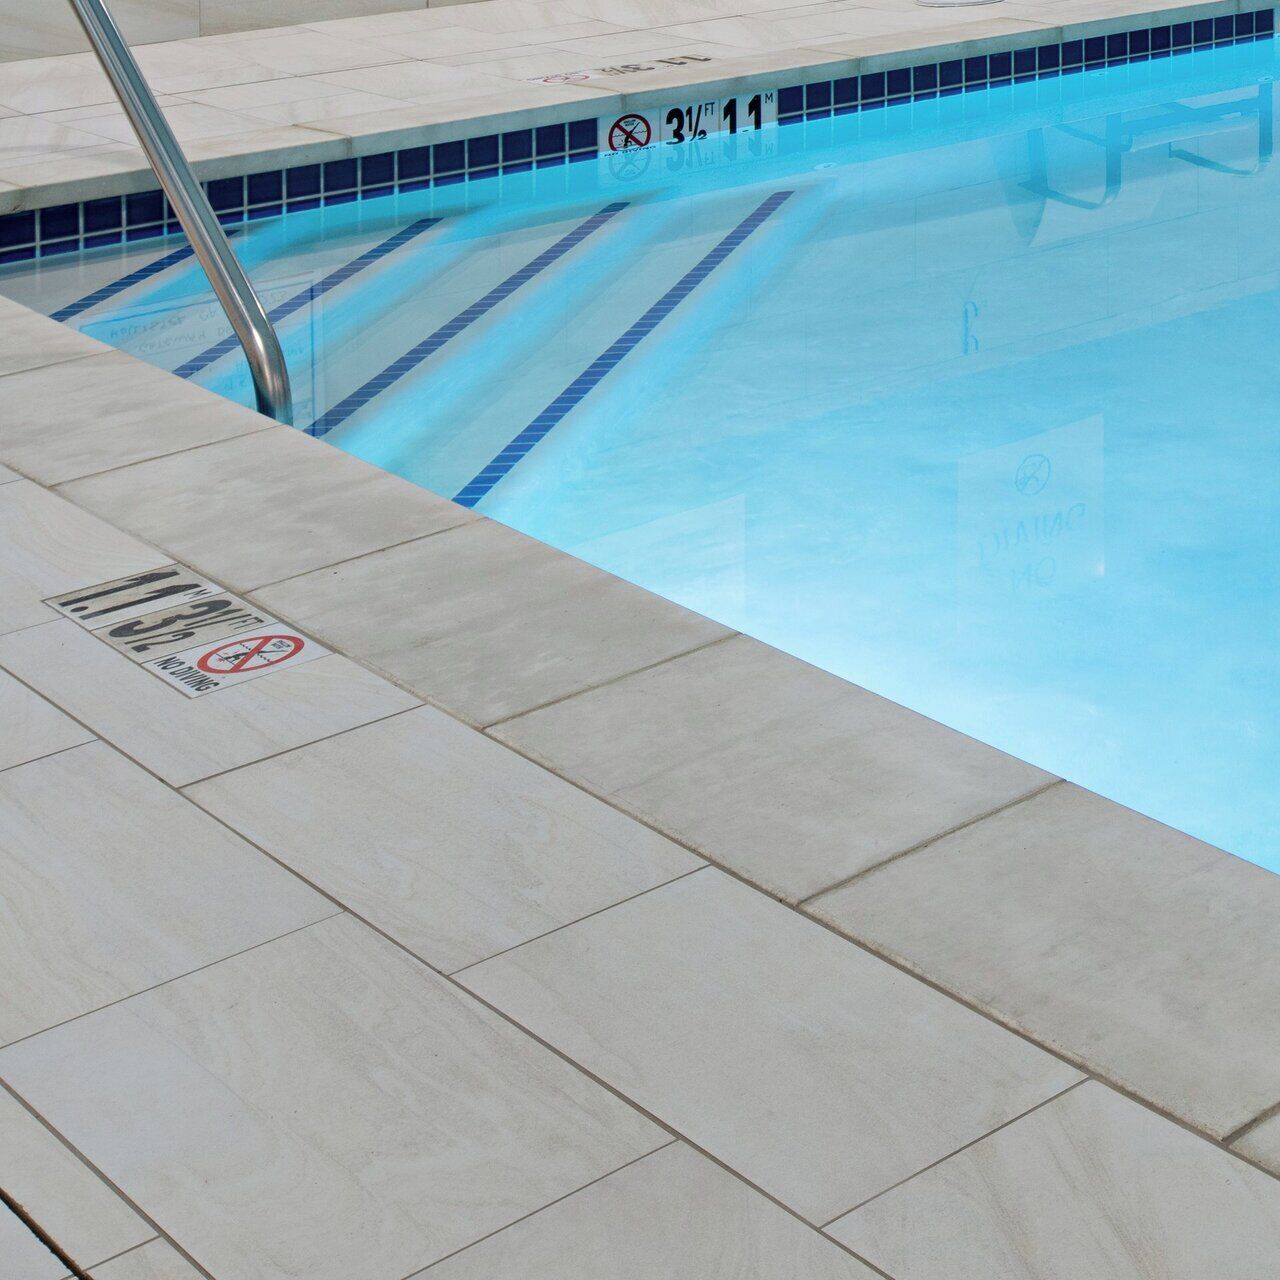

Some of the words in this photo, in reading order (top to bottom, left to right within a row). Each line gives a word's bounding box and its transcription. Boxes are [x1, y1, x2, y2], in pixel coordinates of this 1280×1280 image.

[704, 101, 715, 117] FT
[764, 92, 774, 104] M
[153, 656, 186, 672] NO
[167, 666, 220, 692] DIVING
